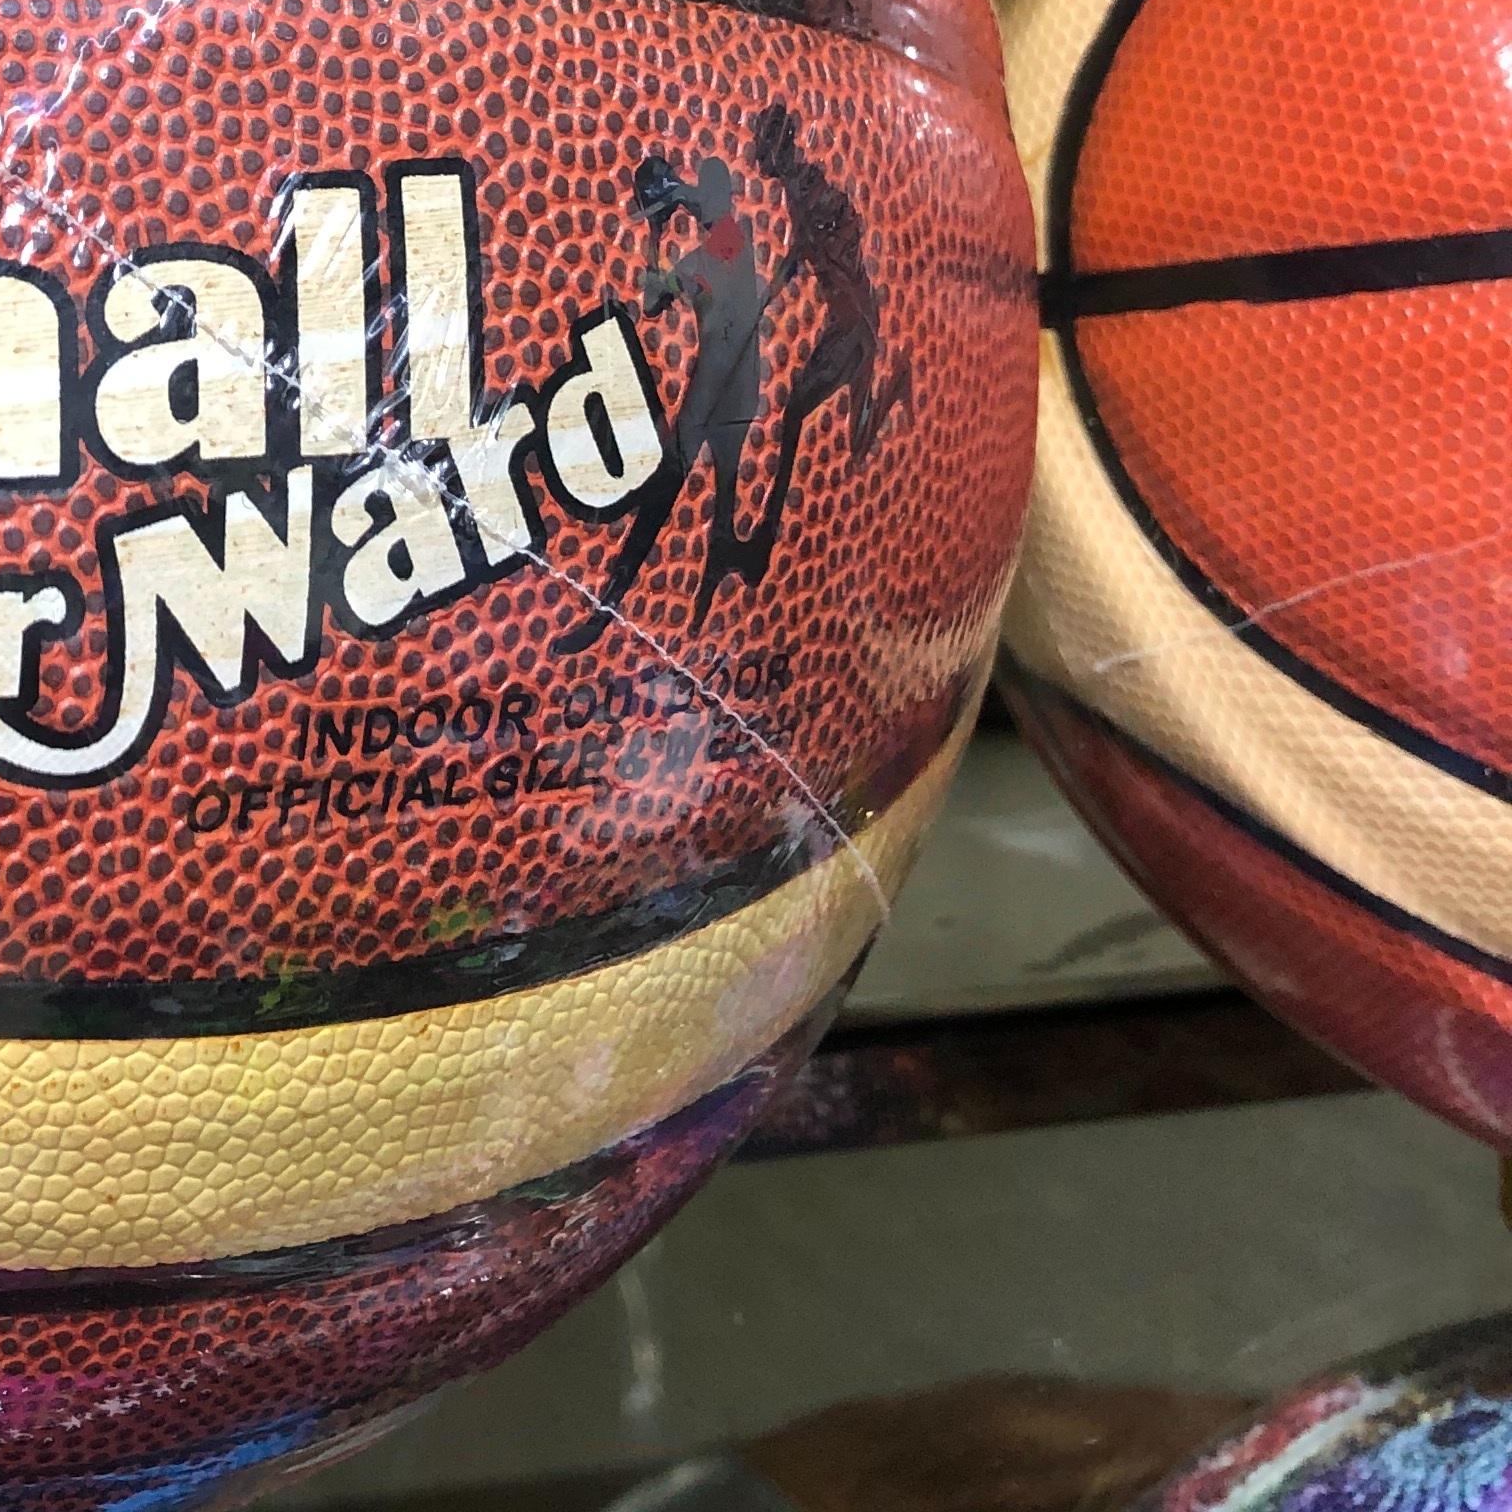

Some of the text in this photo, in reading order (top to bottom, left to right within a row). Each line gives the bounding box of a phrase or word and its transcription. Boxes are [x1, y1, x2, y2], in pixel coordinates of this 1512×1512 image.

[296, 690, 536, 762] INDOOR
[186, 772, 475, 834] OFFICIAL
[487, 733, 605, 799] SIZE
